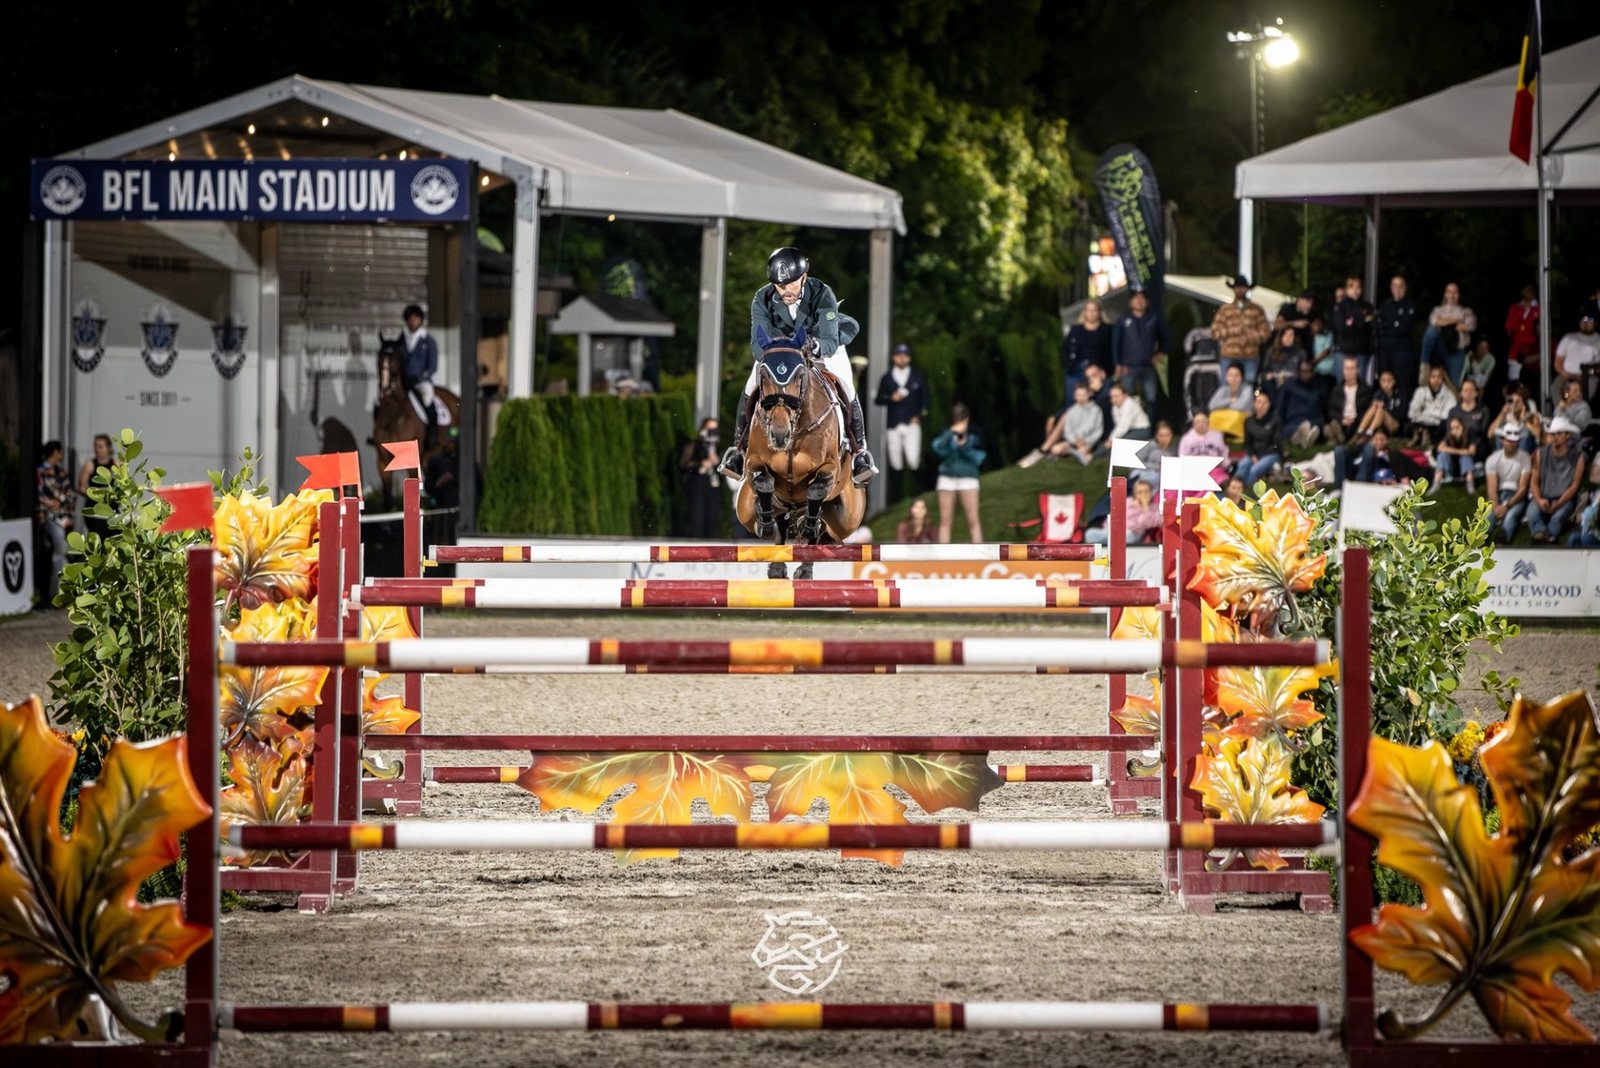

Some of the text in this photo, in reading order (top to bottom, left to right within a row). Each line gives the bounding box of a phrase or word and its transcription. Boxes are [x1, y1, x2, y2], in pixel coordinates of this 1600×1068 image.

[102, 169, 160, 211] BFL
[169, 169, 249, 211] MAIN
[258, 169, 396, 212] STADIUM
[1488, 584, 1582, 598] RUCEWOOD
[1527, 600, 1561, 608] SHOP
